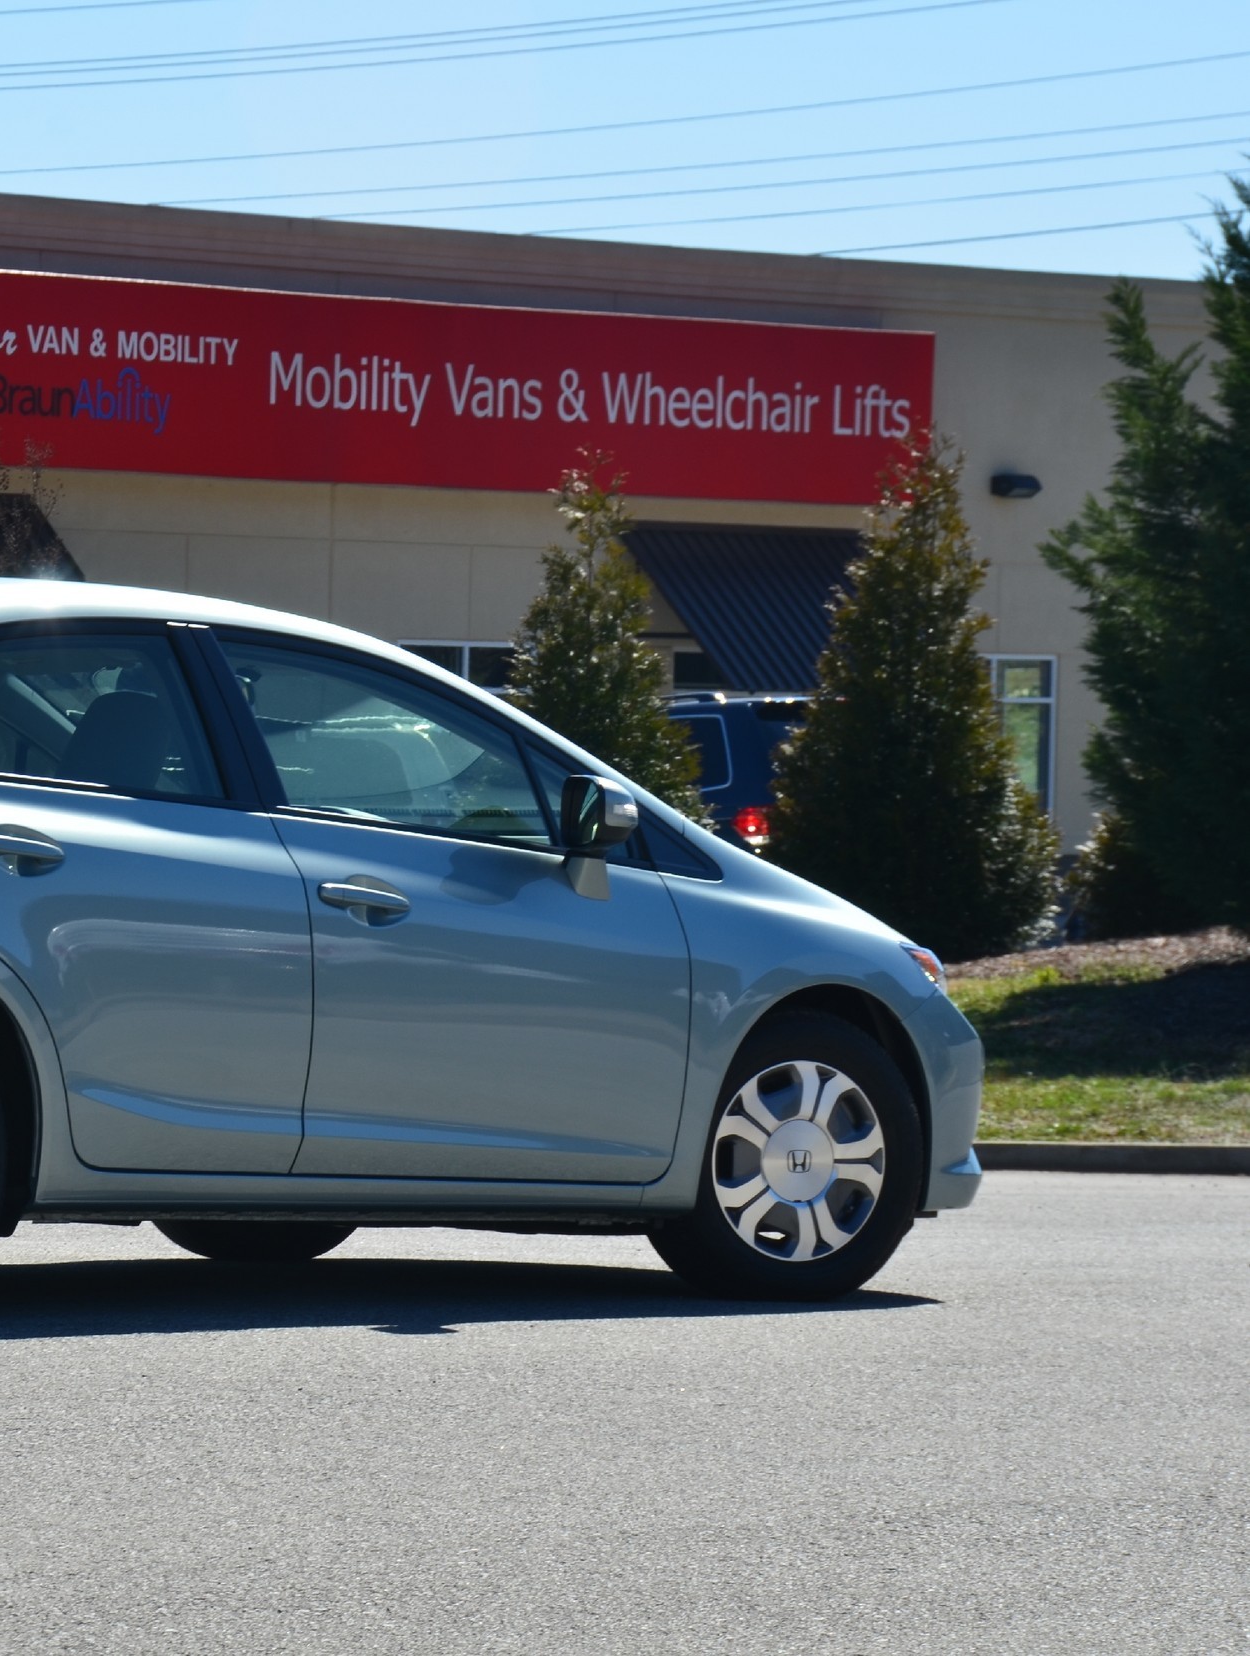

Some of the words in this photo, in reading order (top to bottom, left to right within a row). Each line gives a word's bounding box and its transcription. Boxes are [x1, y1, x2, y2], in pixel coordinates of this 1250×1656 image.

[26, 324, 80, 356] VAN
[89, 328, 107, 358] &
[117, 331, 239, 366] MOBILITY
[269, 350, 431, 427] Mobility
[445, 363, 543, 421] Vans
[556, 368, 589, 423] &
[601, 371, 820, 434] Wheelchair
[831, 385, 911, 438] Lifts
